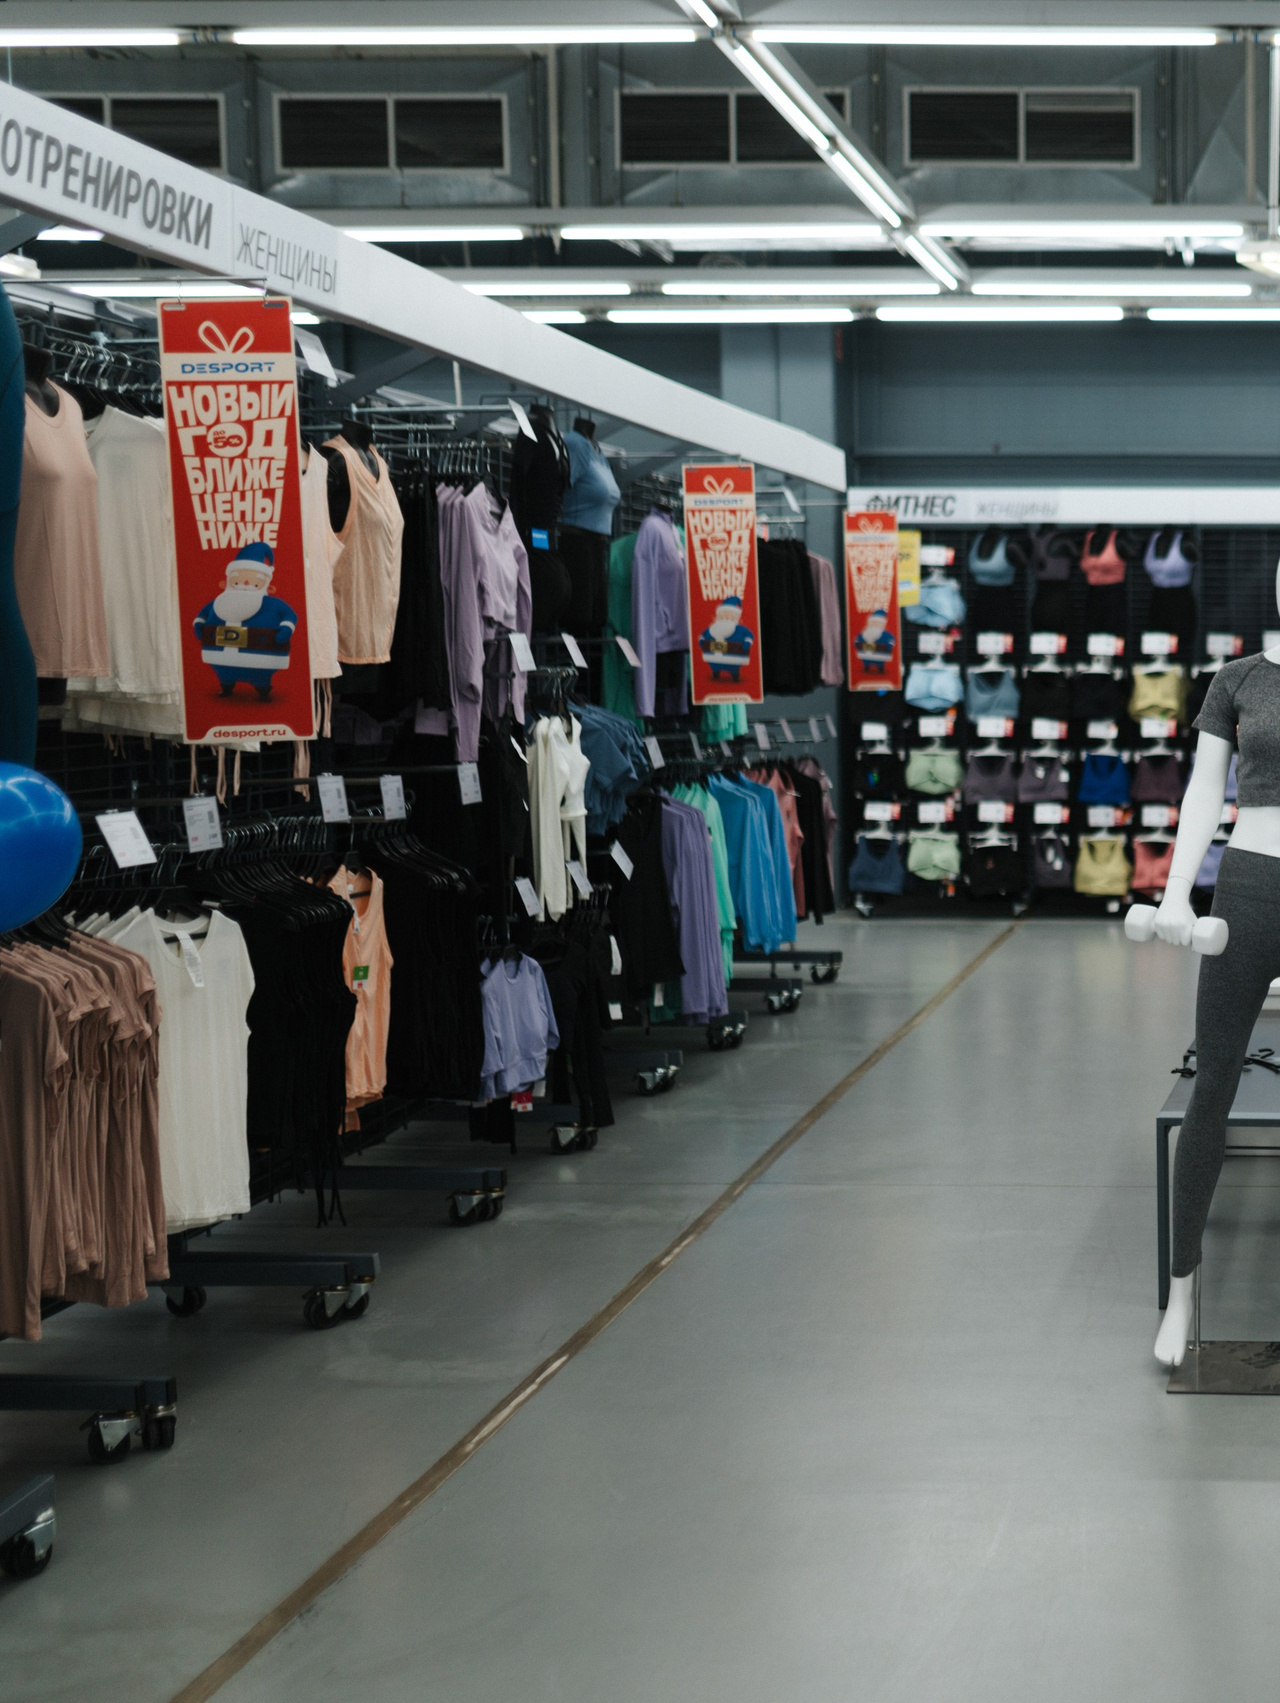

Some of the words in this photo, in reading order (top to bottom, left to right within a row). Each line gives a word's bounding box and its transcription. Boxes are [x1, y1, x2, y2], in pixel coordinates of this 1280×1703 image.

[0, 118, 213, 250] ОТРЕНИРОВКИ
[236, 222, 338, 296] ЖЕНЩИНЫ
[181, 361, 275, 375] DESPORT
[183, 456, 286, 495] БЛИЖЕ
[191, 488, 283, 523] ЦЕНЫ
[865, 495, 956, 517] ФИТНЕС
[197, 520, 279, 550] НИЖЕ
[213, 729, 286, 739] desport.ru
